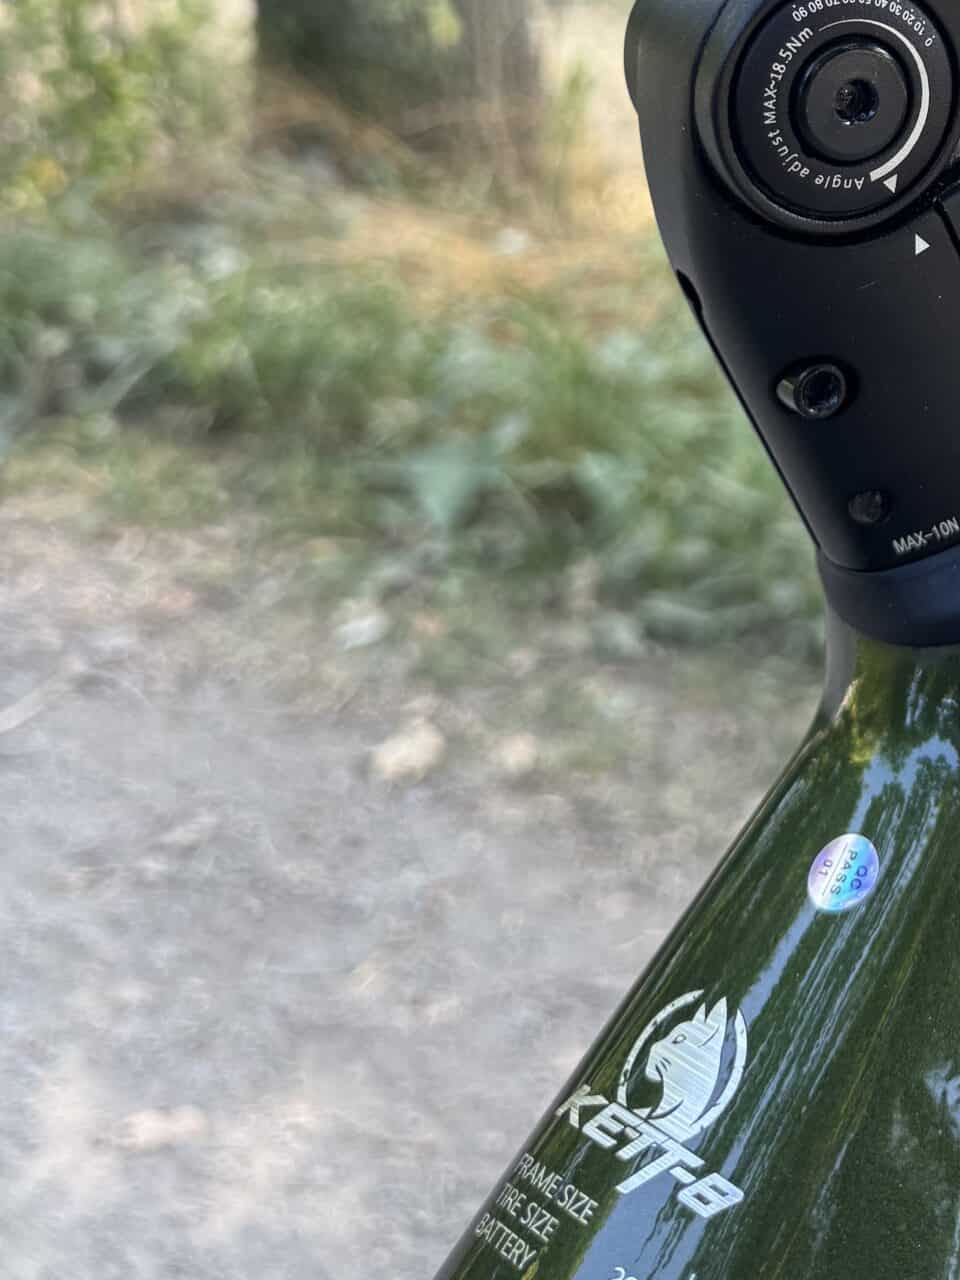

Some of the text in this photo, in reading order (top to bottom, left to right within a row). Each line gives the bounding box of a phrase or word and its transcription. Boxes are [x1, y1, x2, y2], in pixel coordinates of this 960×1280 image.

[792, 7, 808, 22] 90
[808, 0, 824, 14] 80
[889, 2, 901, 16] 30
[902, 10, 916, 25] 20
[914, 22, 926, 36] 10
[925, 37, 933, 48] 0
[768, 129, 810, 177] adjust
[814, 175, 865, 190] Angle
[830, 850, 858, 895] PASS
[513, 1152, 599, 1225] FRAME SIZE
[496, 1182, 560, 1242] TIRE SIZE
[475, 1212, 536, 1270] BATTERY
